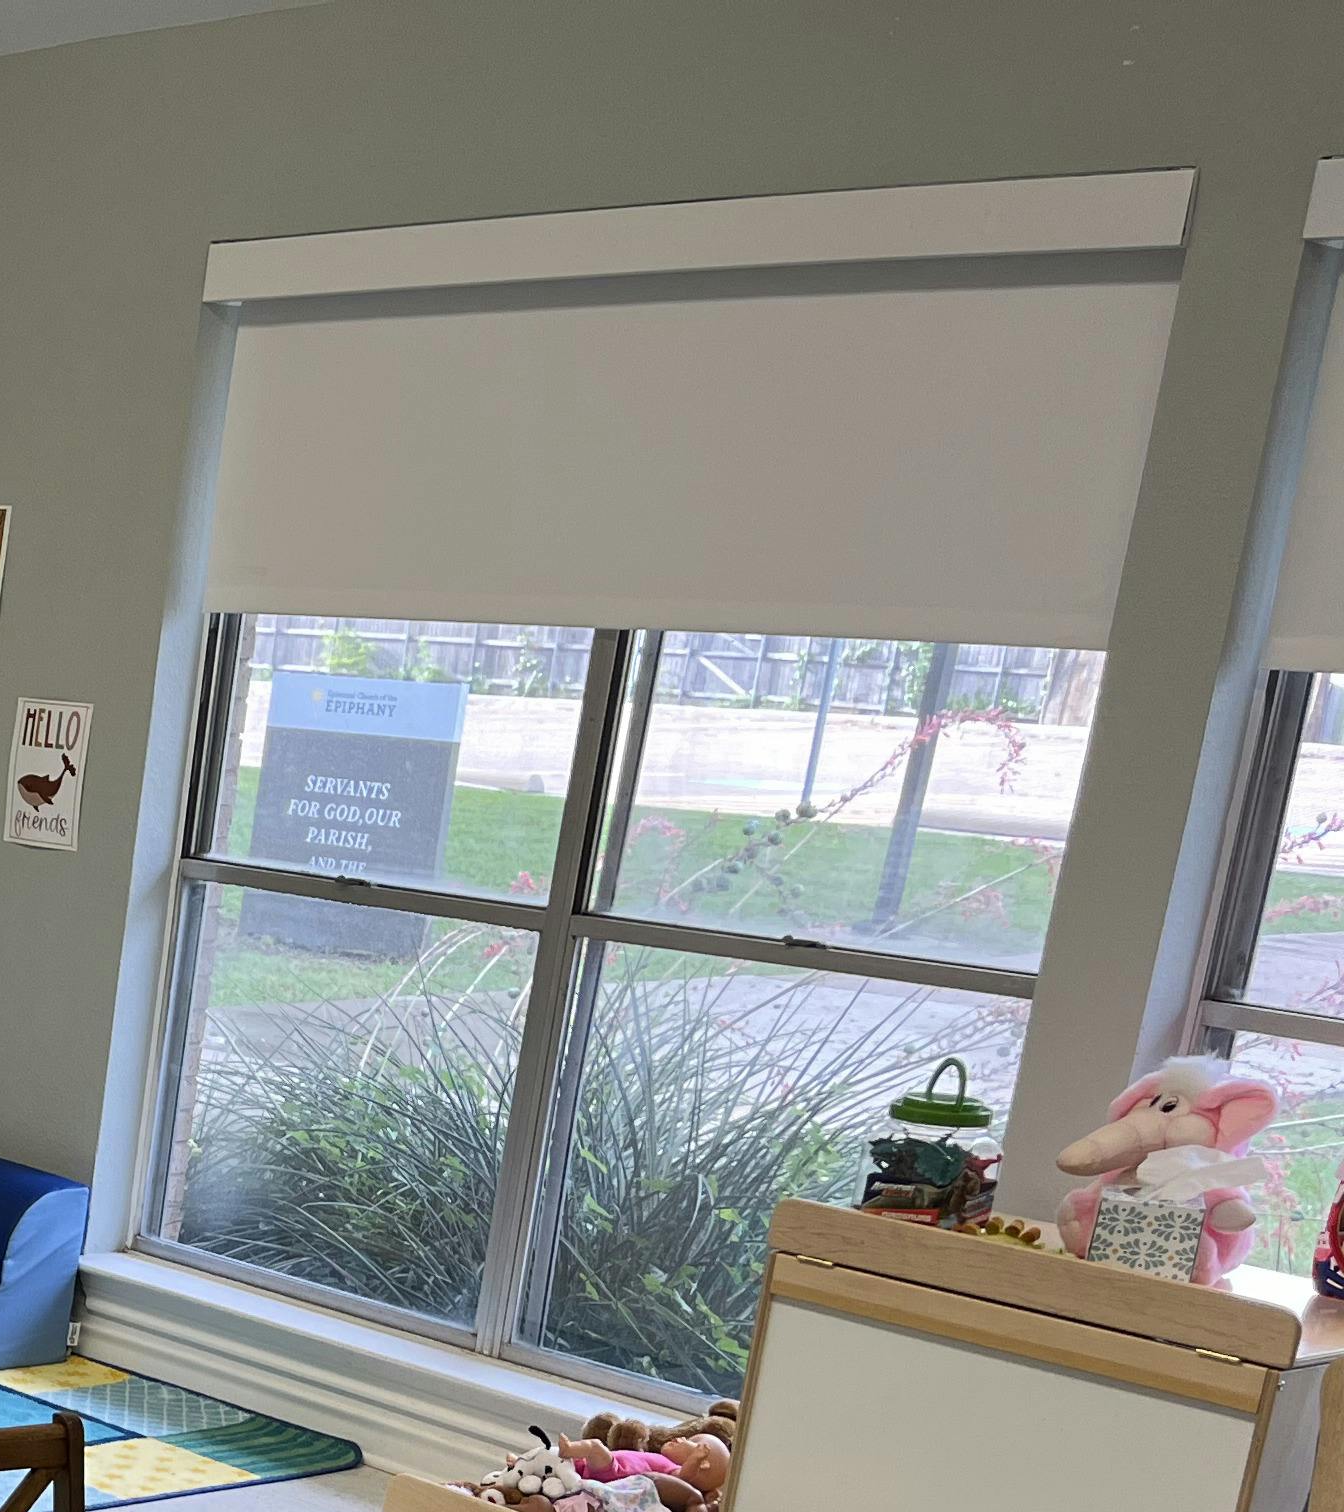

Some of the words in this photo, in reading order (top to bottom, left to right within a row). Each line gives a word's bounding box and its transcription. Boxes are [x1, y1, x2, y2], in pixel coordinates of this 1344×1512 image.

[324, 699, 397, 718] EPIPHANY
[22, 707, 81, 751] HELLO
[304, 774, 391, 800] SERVANTS
[287, 798, 320, 818] FOR
[14, 809, 68, 837] friends
[305, 826, 372, 852] PARISH,
[308, 856, 336, 870] AND
